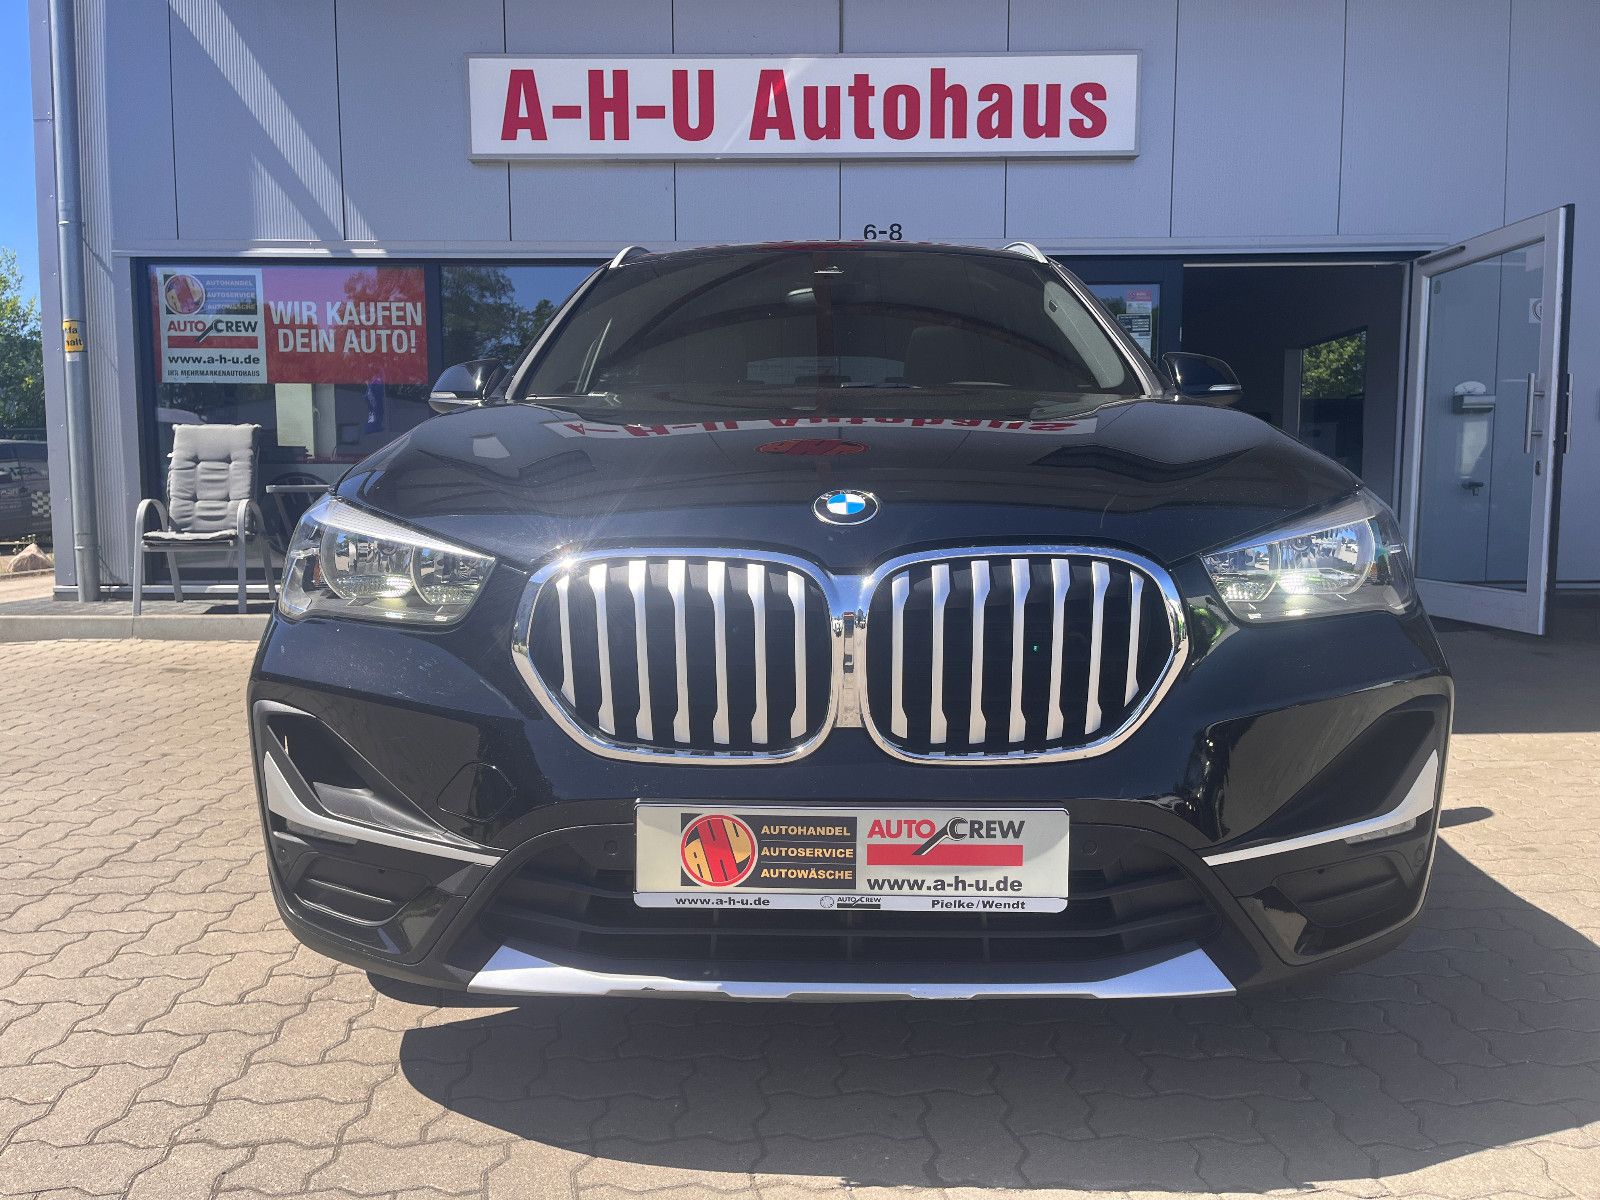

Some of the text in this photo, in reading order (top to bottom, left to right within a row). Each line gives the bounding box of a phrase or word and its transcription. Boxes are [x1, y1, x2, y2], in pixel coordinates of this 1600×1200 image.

[501, 68, 1107, 142] A-H-U Autohaus
[863, 223, 903, 241] 6-8
[269, 301, 422, 326] WIR KAUFEN
[168, 319, 258, 333] AUTO CREW
[278, 329, 416, 354] DEIN AUTO!
[168, 354, 260, 365] www.a-h-u.de
[180, 369, 260, 377] MEHRMARKENAUTOHAUS
[760, 825, 851, 837] AUTOHANDEL
[867, 817, 1026, 841] AUTO CREW
[760, 847, 854, 859] AUTOSERVICE
[760, 867, 853, 880] AUTOWÄSCHE
[867, 876, 1023, 892] www.a-h-u.de
[675, 896, 770, 906] www.a-h-u.de
[931, 899, 1026, 910] Pielke/Wendt
